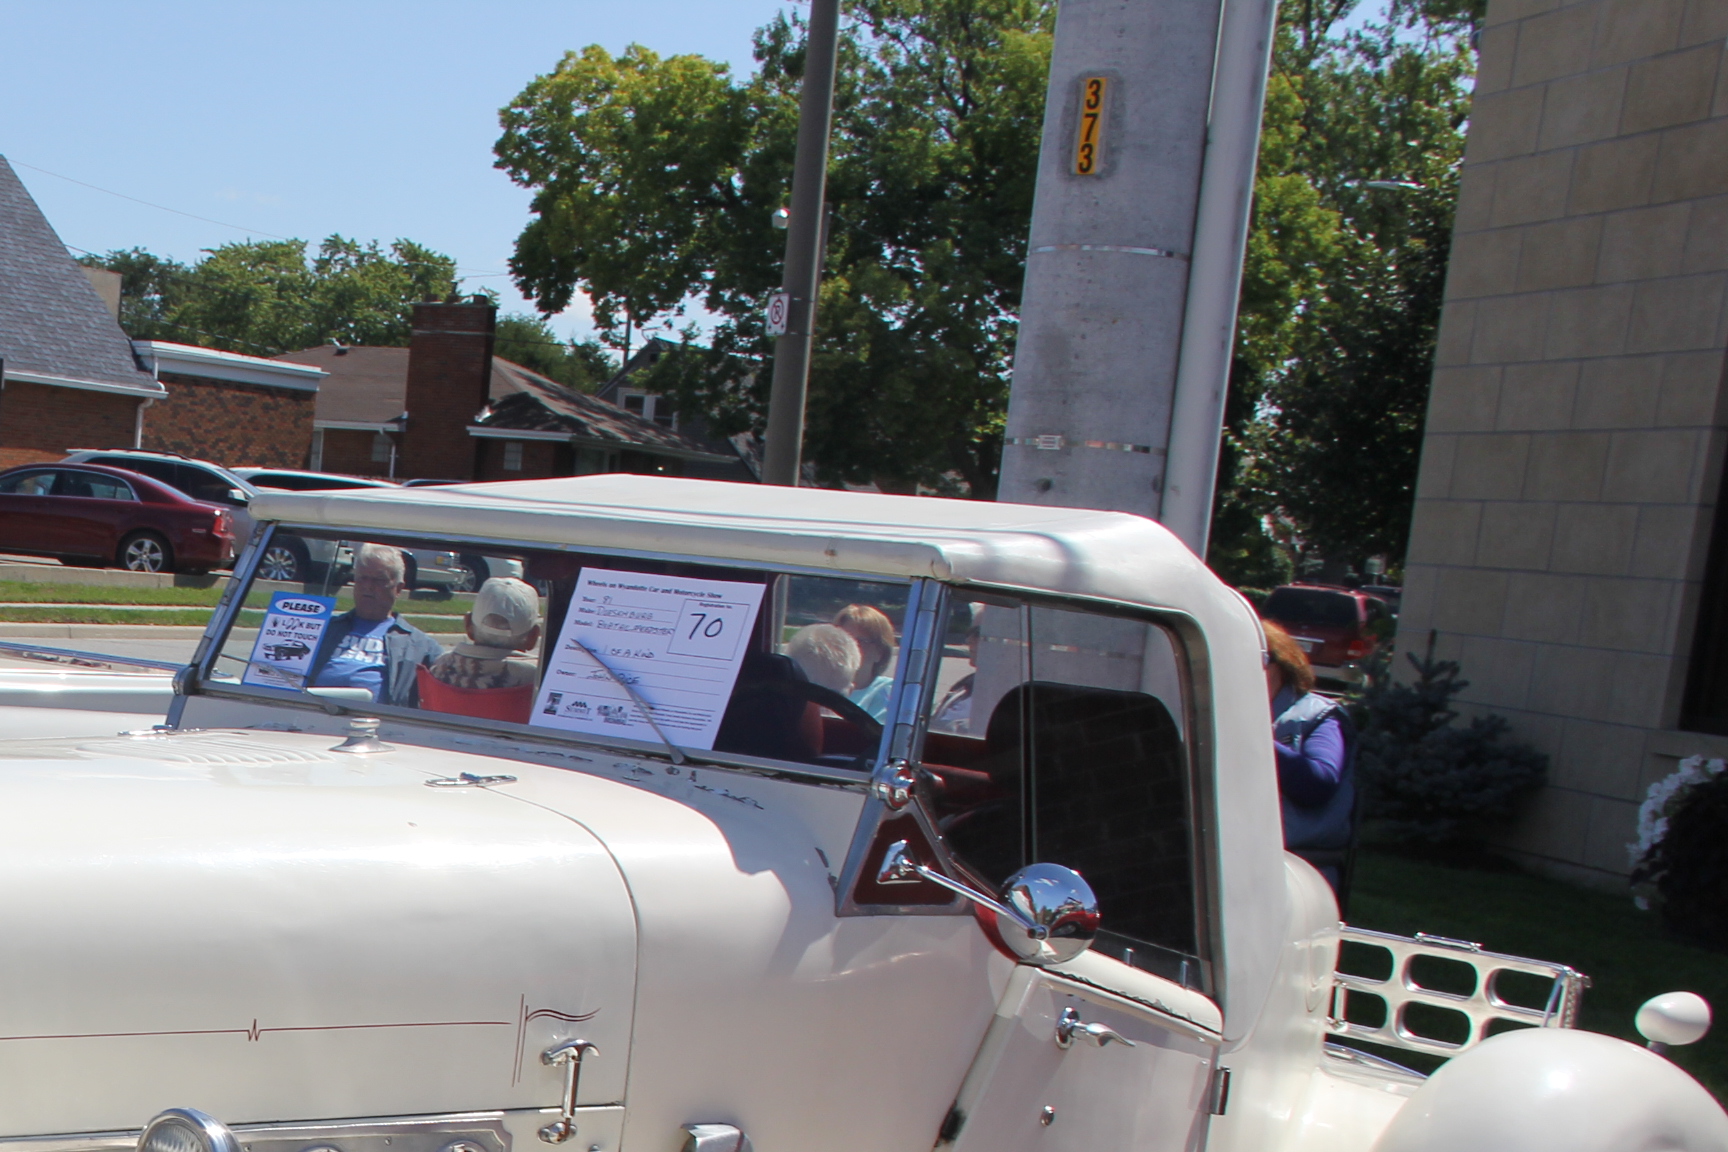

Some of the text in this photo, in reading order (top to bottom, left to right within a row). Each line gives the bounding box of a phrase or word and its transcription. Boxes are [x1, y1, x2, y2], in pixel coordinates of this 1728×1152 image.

[1078, 79, 1102, 173] 373
[587, 579, 607, 587] Wheels
[649, 585, 660, 593] Car
[661, 587, 673, 595] and
[674, 588, 705, 598] Motorcycle
[282, 601, 320, 613] PLEASE
[266, 628, 276, 636] DO
[293, 632, 319, 641] TOUCH
[305, 622, 321, 631] BUT
[690, 613, 722, 640] 70
